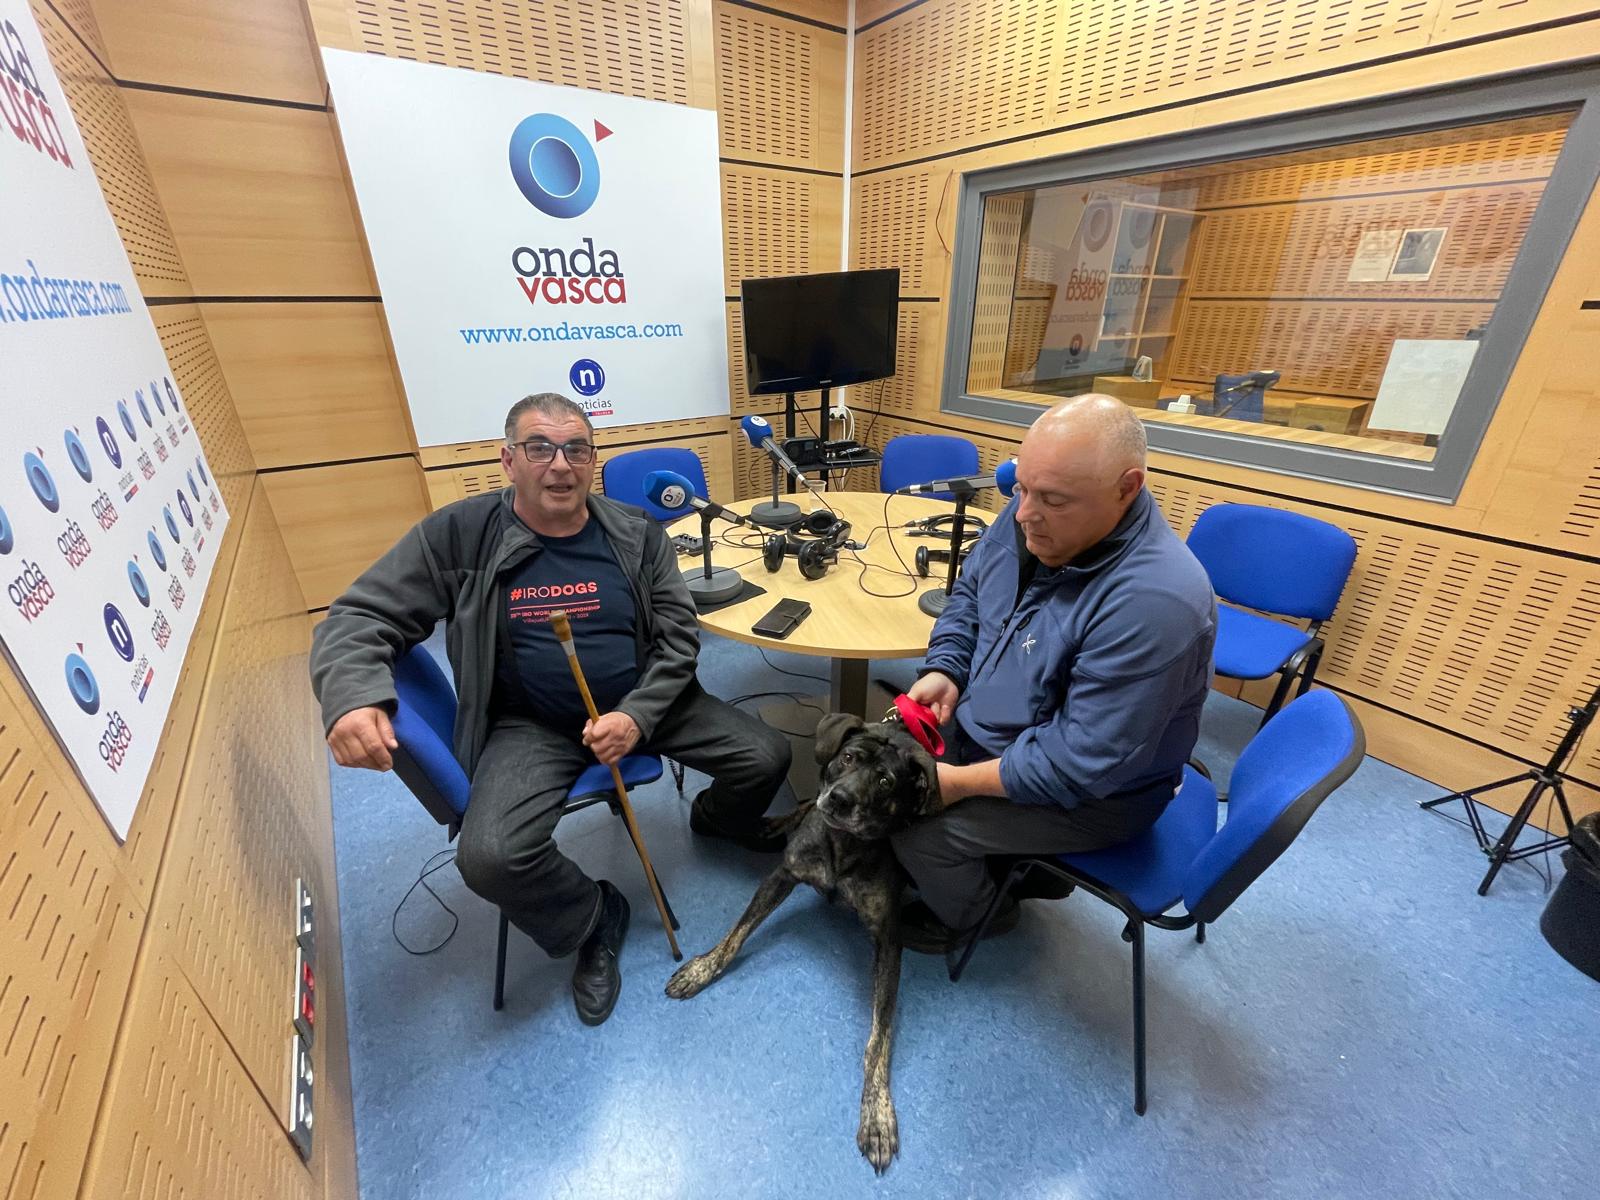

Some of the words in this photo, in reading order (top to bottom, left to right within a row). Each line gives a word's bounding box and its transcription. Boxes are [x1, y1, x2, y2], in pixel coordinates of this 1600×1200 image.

[0, 74, 75, 170] asca
[512, 237, 624, 278] onda
[0, 259, 132, 323] .ondavasca.com
[516, 277, 627, 305] vasca
[460, 321, 684, 344] www.ondavasca.com
[579, 369, 596, 386] n
[577, 398, 612, 410] oticias
[91, 488, 113, 519] onda
[98, 505, 119, 532] vasca
[57, 517, 84, 556] onda
[65, 537, 92, 570] vasca
[8, 559, 46, 607] onda
[510, 581, 598, 601] #IRODOGS
[18, 579, 56, 624] vasca
[99, 710, 127, 761] onda
[107, 726, 132, 774] vasca
